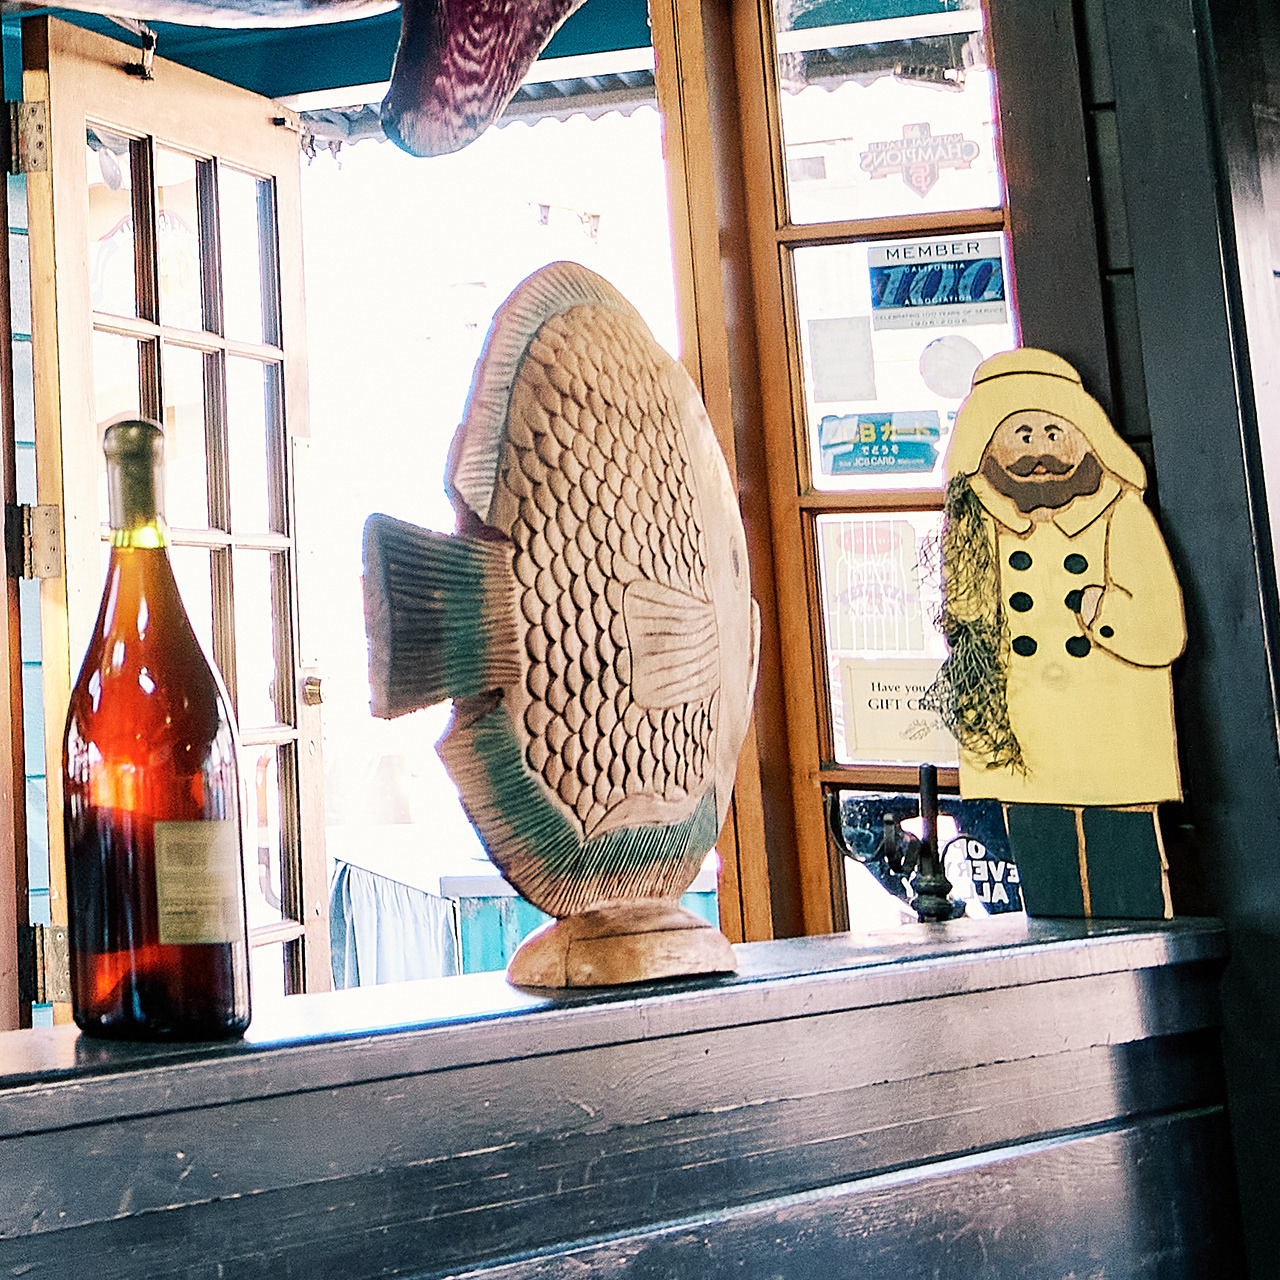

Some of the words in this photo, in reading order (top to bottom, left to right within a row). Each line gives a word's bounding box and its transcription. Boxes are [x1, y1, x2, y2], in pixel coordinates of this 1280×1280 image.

[886, 241, 981, 261] MEMBER
[904, 263, 966, 274] CALIFORNIA
[904, 295, 972, 306] ASSOCIATION
[875, 312, 920, 321] CELEBRATING
[939, 310, 960, 318] YEARS
[975, 307, 1004, 315] SERVICE
[853, 457, 870, 467] JCB
[871, 456, 896, 467] CARD
[870, 681, 901, 693] Have
[868, 698, 902, 711] GIFT
